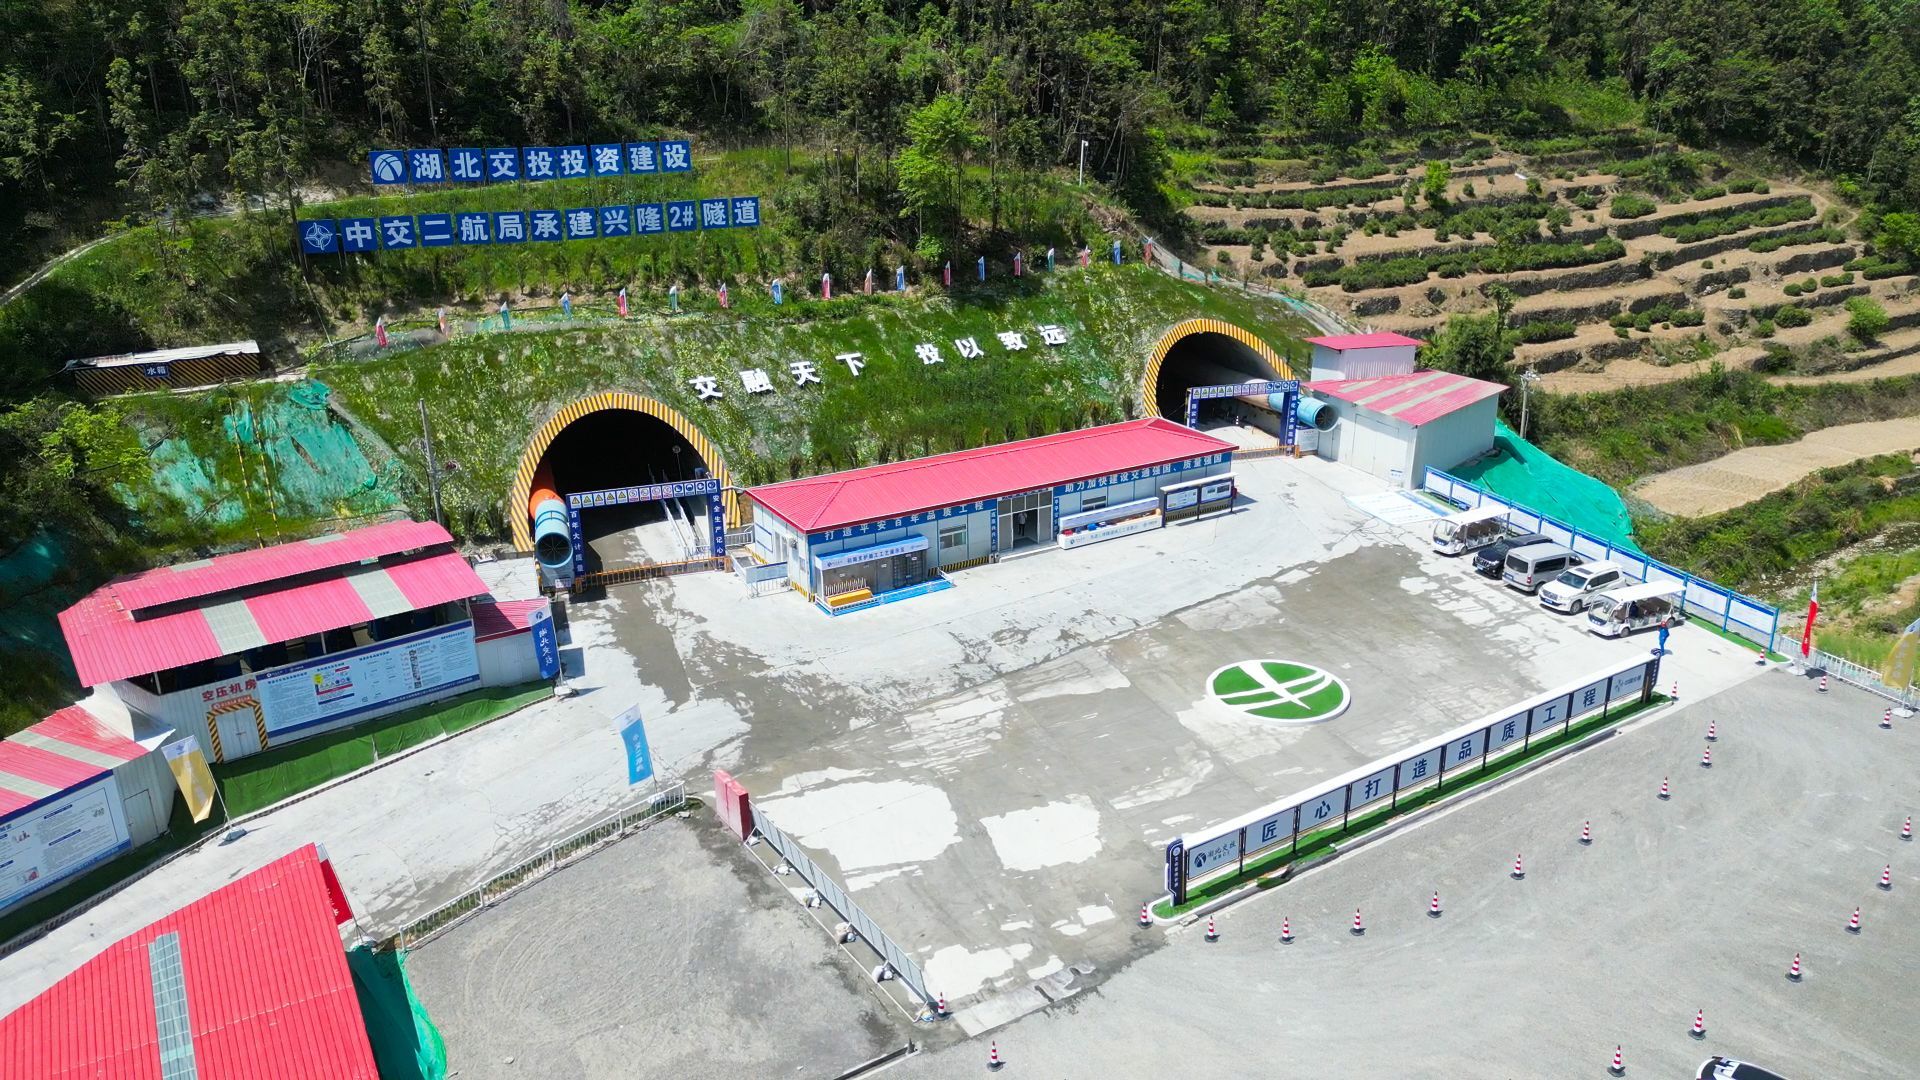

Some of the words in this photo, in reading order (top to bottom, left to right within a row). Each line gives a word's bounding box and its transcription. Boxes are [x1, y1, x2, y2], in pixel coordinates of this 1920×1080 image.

[413, 143, 688, 180] 湖北交投投资建设
[346, 201, 758, 249] 中交二航局承建兴隆2#隧道
[146, 366, 166, 376] 水箱
[689, 353, 865, 400] 交融天下
[914, 325, 1067, 365] 投以致远
[1064, 453, 1222, 493] 助力加快建设交通强国、质量强国
[824, 500, 984, 541] 打造平安百年品质工程
[201, 678, 258, 702] 空压机房
[1261, 688, 1598, 842] 匠心打造品质工程
